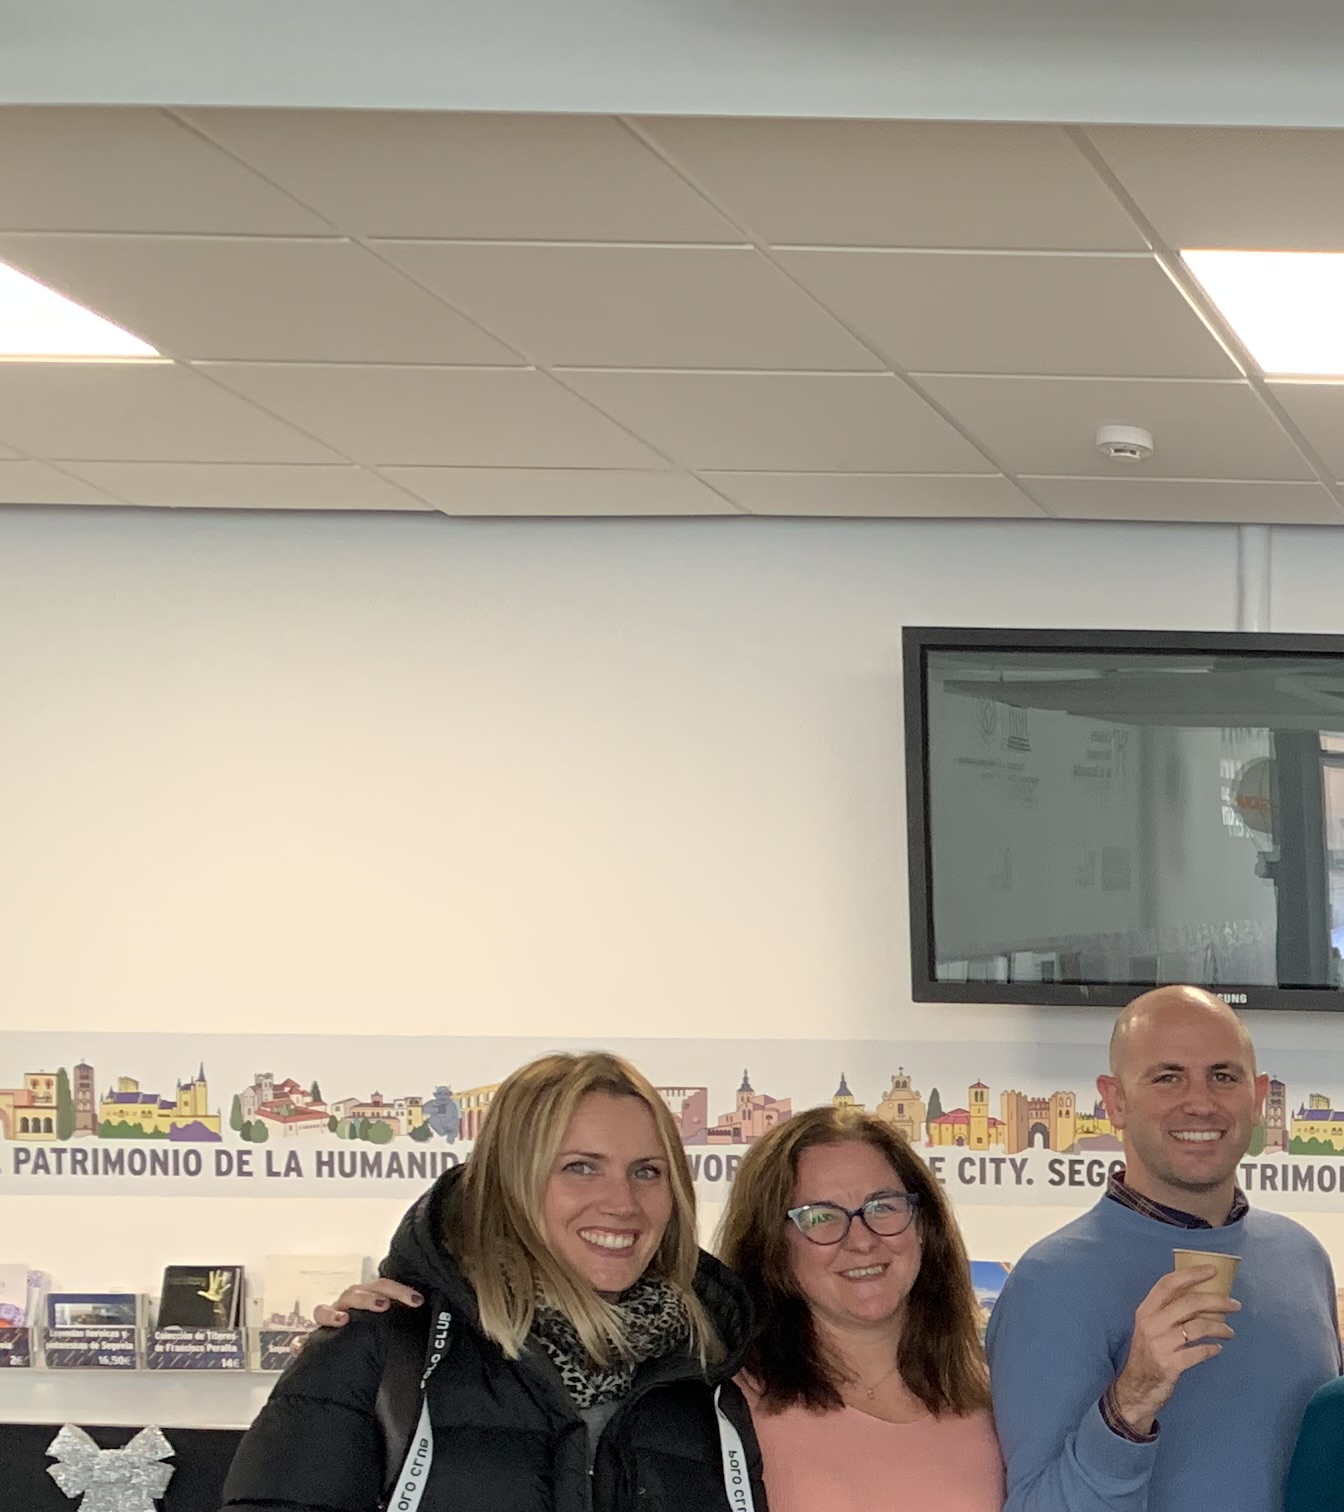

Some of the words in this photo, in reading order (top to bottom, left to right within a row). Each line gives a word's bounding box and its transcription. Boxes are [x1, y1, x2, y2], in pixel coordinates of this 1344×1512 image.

[1216, 993, 1248, 1004] SUNG
[13, 1147, 202, 1176] PATRIMONIO
[215, 1150, 254, 1178] DE
[266, 1151, 304, 1178] LA
[316, 1151, 474, 1179] HUMANID
[686, 1154, 744, 1182] WOR
[957, 1156, 1034, 1186] CITY.
[434, 1311, 453, 1350] CLUB
